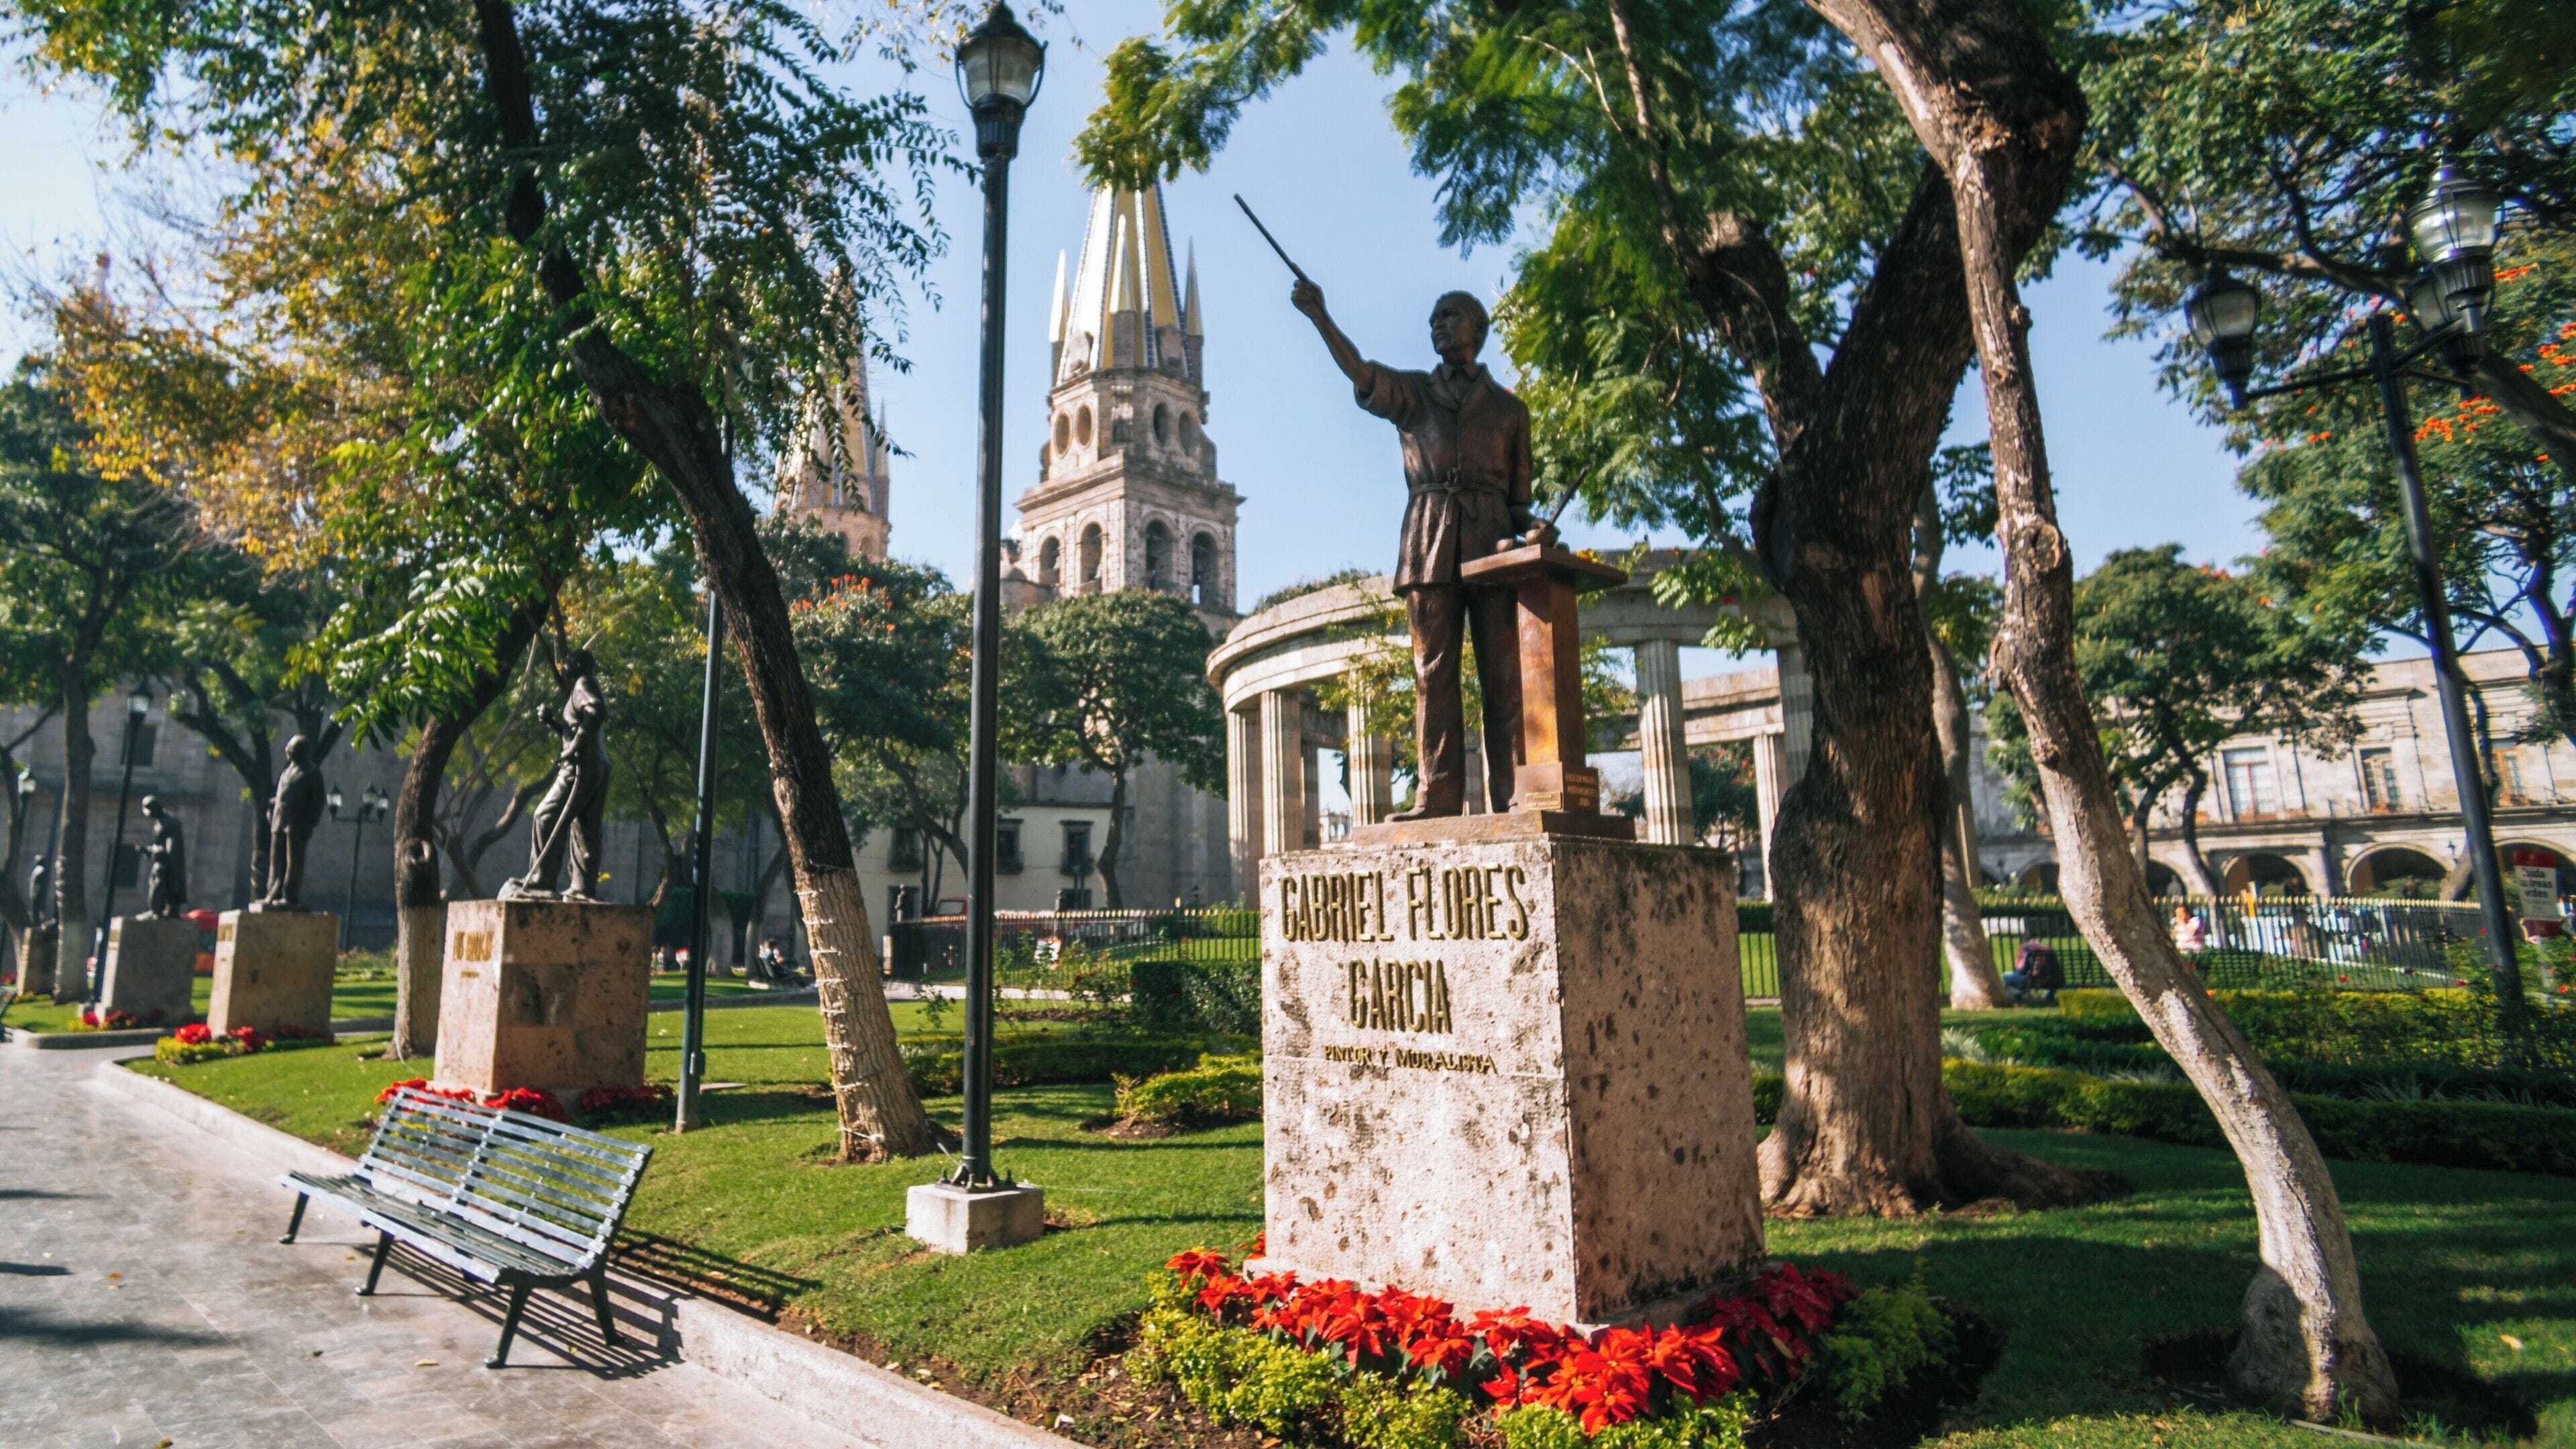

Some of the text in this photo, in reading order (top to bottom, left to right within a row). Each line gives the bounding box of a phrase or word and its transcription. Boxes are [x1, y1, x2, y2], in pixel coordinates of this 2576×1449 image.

[1281, 863, 1529, 941] GABRIEL FLORES
[1349, 955, 1452, 1034] GARCIA
[1322, 1044, 1499, 1075] PINTOR Y MURALISTA
